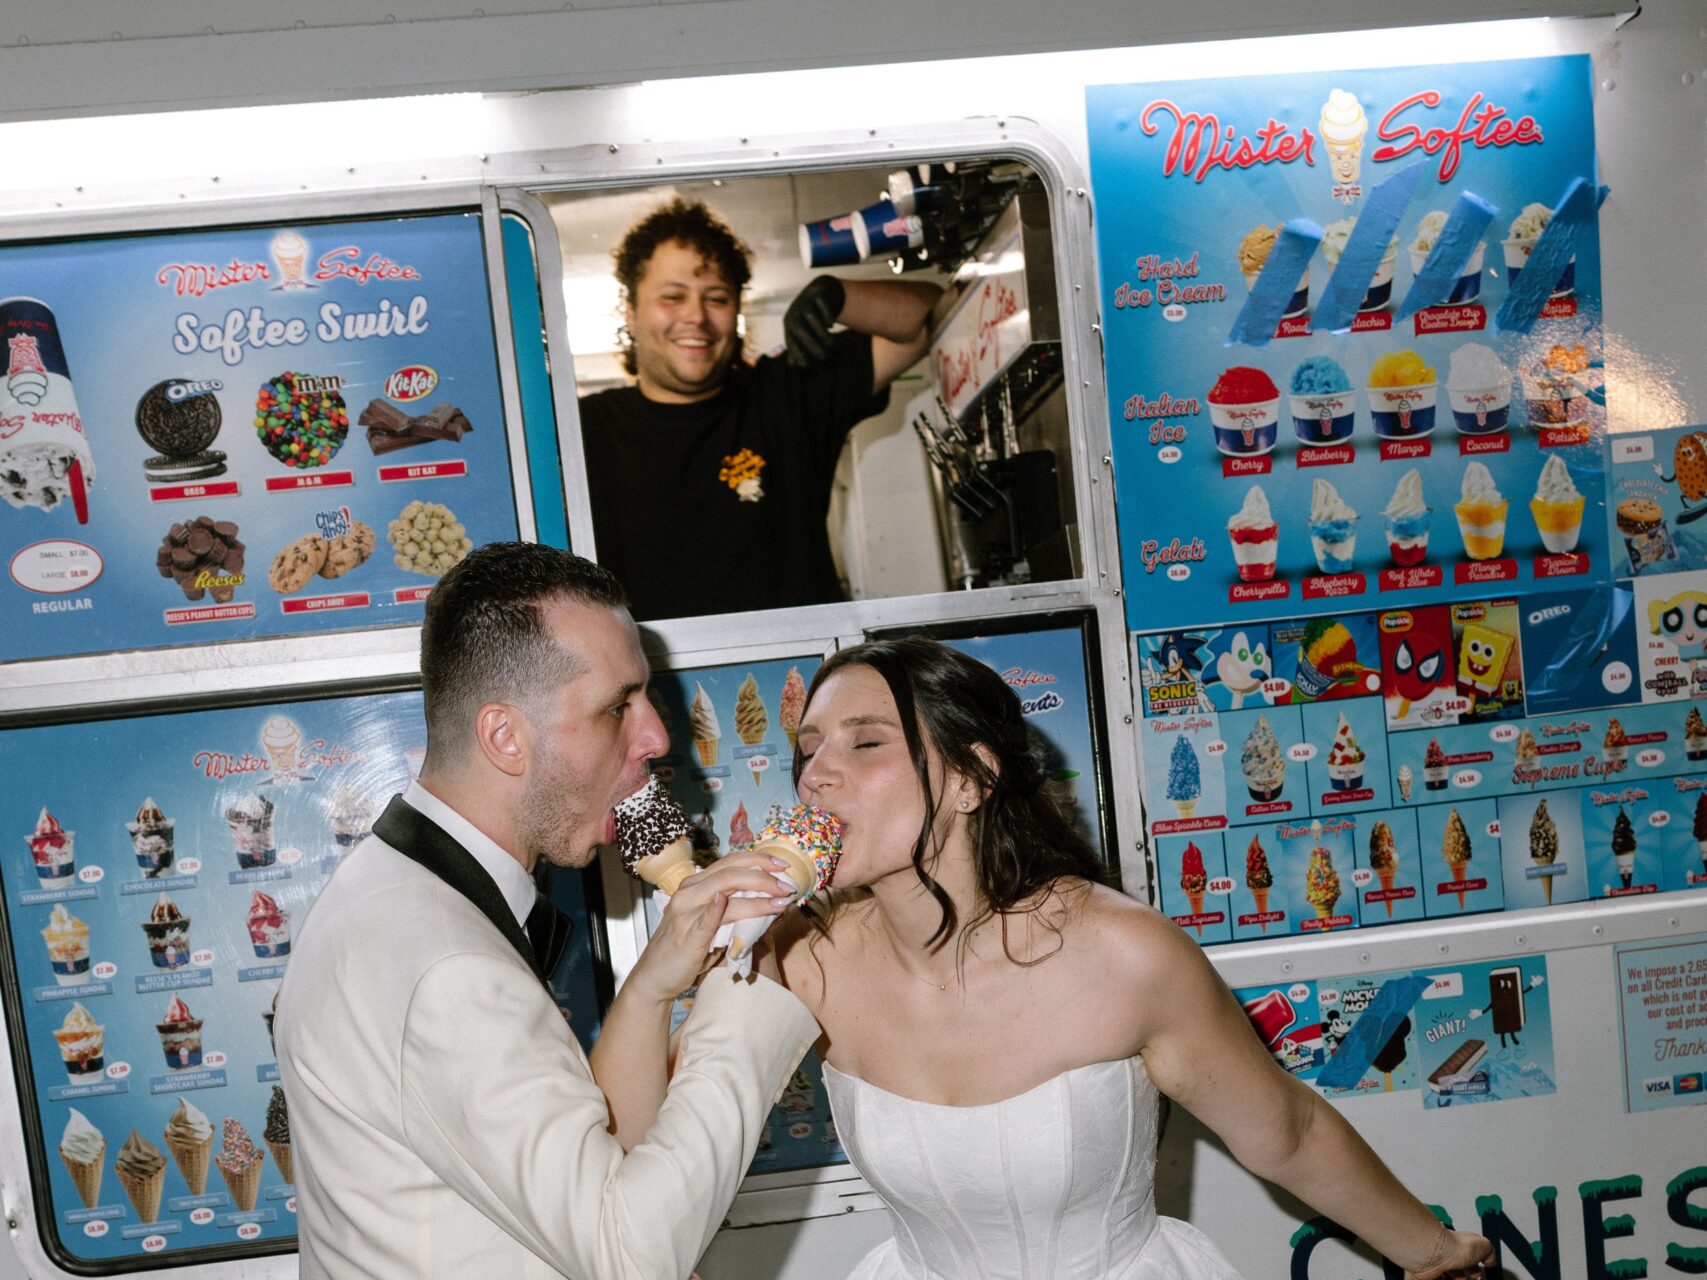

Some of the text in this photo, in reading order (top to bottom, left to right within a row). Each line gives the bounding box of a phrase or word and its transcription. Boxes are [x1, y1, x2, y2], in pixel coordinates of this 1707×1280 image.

[1140, 90, 1544, 183] Mister Softee
[157, 246, 420, 297] Mister Softee
[1136, 251, 1200, 280] Hard
[1115, 279, 1227, 308] Ice Cream
[1419, 309, 1481, 323] Chocolate Chip
[1352, 317, 1386, 329] stachio
[1420, 318, 1480, 330] Cookie Dough
[173, 296, 428, 366] Softee Swirl
[166, 379, 224, 402] OREO
[1125, 392, 1200, 421] Italian
[1149, 420, 1186, 444] Ice
[1547, 433, 1581, 443] Patriot
[1387, 444, 1425, 457] Mango
[1466, 439, 1504, 451] Coconut
[1300, 450, 1351, 463] Blueberry
[408, 466, 437, 477] KIT KAT
[1231, 460, 1264, 473] Cherry
[183, 487, 206, 496] OREO
[316, 510, 344, 529] Chips
[1141, 537, 1207, 573] Gelati
[1408, 570, 1436, 579] White
[1469, 563, 1501, 574] Mango
[1547, 566, 1577, 576] Dream
[1407, 577, 1429, 587] Blue
[1467, 571, 1507, 581] Paradise
[1309, 577, 1359, 590] Blueberry
[1233, 585, 1287, 599] Cherrynilla
[32, 598, 93, 614] REGULAR
[306, 598, 345, 609] CHIPS AHOY
[1528, 604, 1571, 625] OREO
[1654, 657, 1679, 667] CHERRY
[1149, 682, 1197, 702] SONIC
[1263, 681, 1286, 693] $4.00
[1022, 693, 1061, 714] ents
[1445, 701, 1466, 711] $4.00
[1151, 717, 1214, 734] Mister Softee
[194, 751, 270, 780] Mister
[750, 759, 768, 768] $4.00
[1512, 755, 1628, 789] Supreme Cups
[1270, 804, 1288, 812] Candy
[1154, 819, 1221, 832] Blue Sprinkle Cone
[1277, 818, 1357, 839] Mister Softee
[123, 877, 197, 891] CHOCOLATE SUNDAE
[1209, 881, 1231, 892] $4.00
[22, 888, 96, 902] STRAWBERRY SUNDAE
[1192, 914, 1220, 925] Supreme
[247, 968, 274, 977] CHERRY
[1628, 968, 1642, 980] We
[1645, 966, 1677, 978] impose
[1680, 966, 1685, 974] a
[182, 976, 212, 987] SUNDAE
[1627, 983, 1639, 994] on
[1641, 980, 1653, 992] all
[1655, 977, 1683, 990] Credit
[42, 984, 108, 998] PINEAPPLE SUNDAE
[1642, 993, 1670, 1006] which
[1672, 992, 1680, 1002] is
[1682, 989, 1697, 1001] not
[1647, 1009, 1662, 1019] our
[1665, 1004, 1685, 1017] cost
[1687, 1003, 1696, 1014] of
[1666, 1018, 1683, 1030] and
[1425, 1019, 1467, 1043] GIANT!
[1655, 1037, 1707, 1062] Thank
[165, 1073, 211, 1084] STRAWBERRY
[193, 1076, 225, 1087] SUNDAE
[61, 1087, 90, 1097] CARAMEL
[1645, 1080, 1671, 1093] VISA
